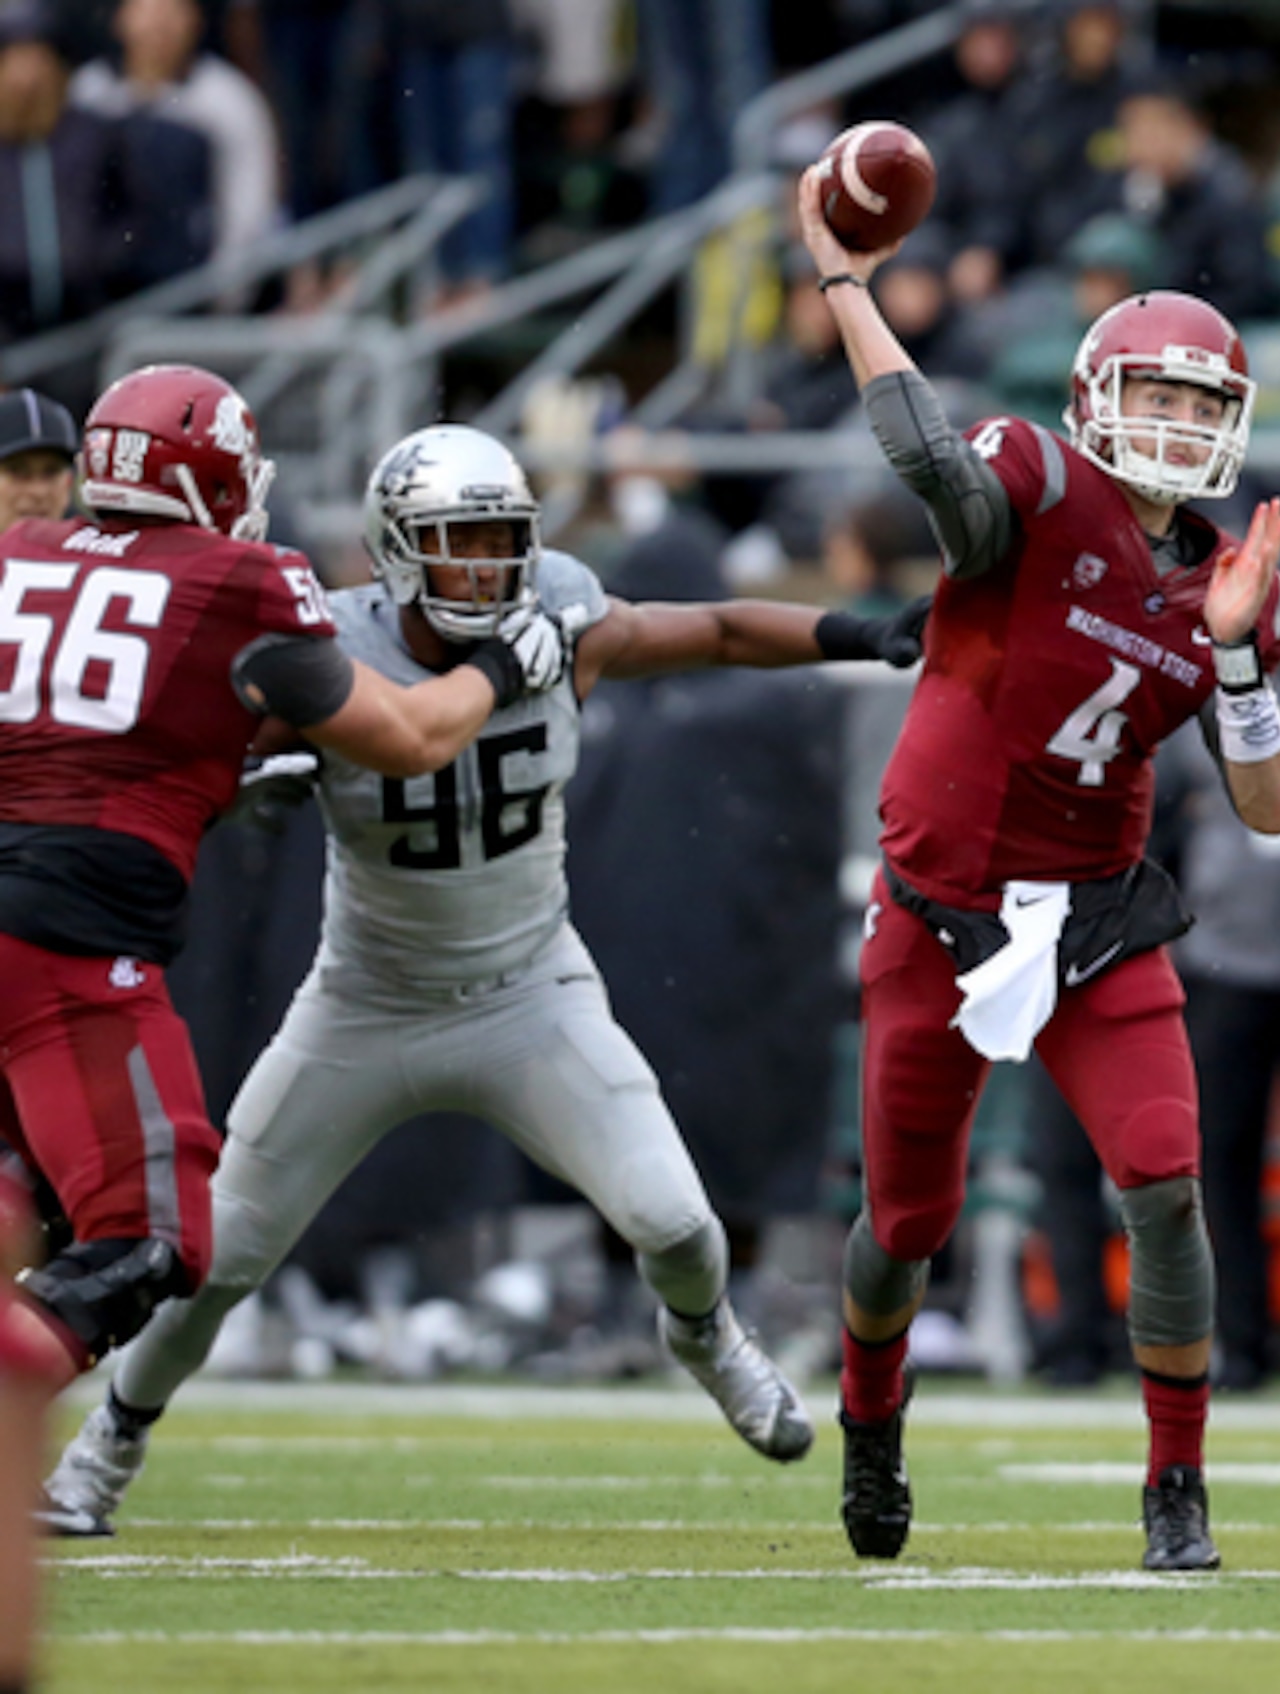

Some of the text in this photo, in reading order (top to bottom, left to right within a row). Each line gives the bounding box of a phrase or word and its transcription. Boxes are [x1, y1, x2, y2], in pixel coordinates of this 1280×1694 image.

[972, 417, 1012, 458] 4
[0, 559, 172, 734] 56
[1065, 604, 1164, 668] WASHINGTON
[1160, 651, 1203, 689] STATE
[1045, 656, 1141, 786] 4
[382, 721, 549, 870] 96
